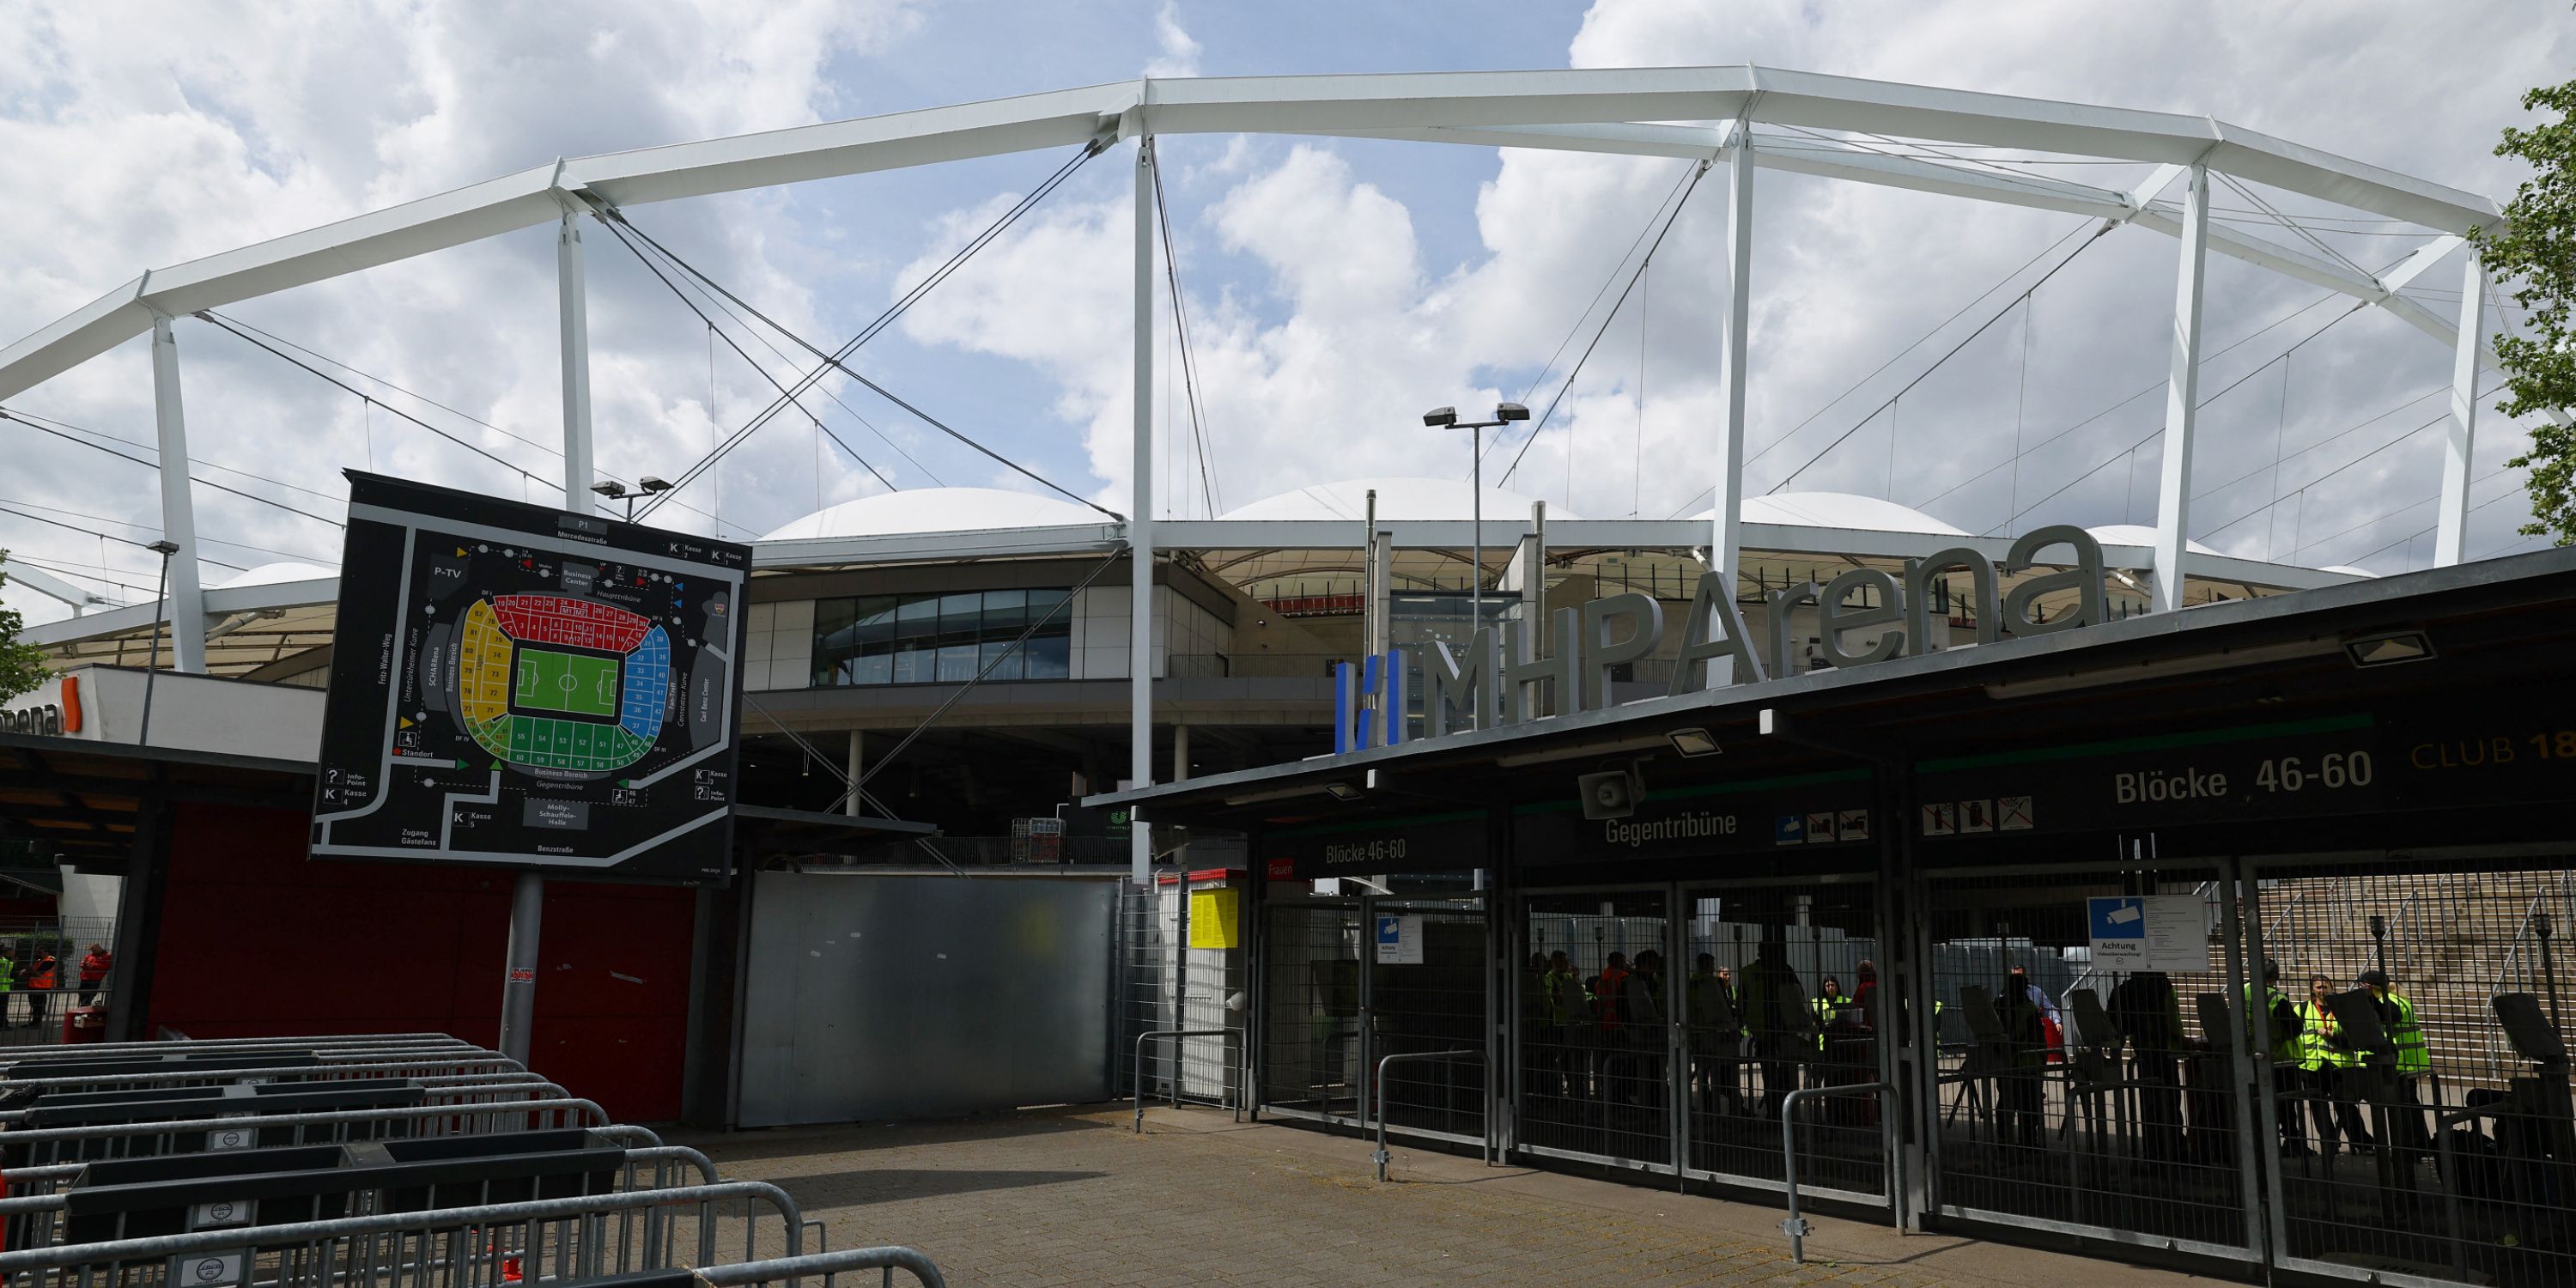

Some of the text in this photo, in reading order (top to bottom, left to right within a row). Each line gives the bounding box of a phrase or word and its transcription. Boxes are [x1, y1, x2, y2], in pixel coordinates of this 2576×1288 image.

[579, 521, 588, 529] P1
[558, 531, 607, 545] Mercedesstraße
[685, 545, 701, 553] Kasse
[726, 552, 741, 560] Kasse
[434, 567, 461, 578] P-TV
[564, 570, 591, 579] Business
[565, 578, 588, 586] Center
[597, 591, 641, 602] Haupttribüne
[378, 633, 392, 685] Fritz-Walter-Weg
[429, 647, 439, 687] SCHARRena
[446, 642, 457, 692] Business Bereich
[404, 648, 416, 702] Untertürkheimer
[402, 749, 433, 758] Standort
[2411, 736, 2515, 770] CLUB
[535, 768, 562, 776] Business
[2115, 750, 2372, 804] Blöcke 46-60
[536, 780, 584, 790] Gegentribüne
[402, 829, 429, 838] Zugang
[1605, 811, 1736, 847] Gegentribüne
[401, 837, 436, 846] Gästefans
[538, 845, 573, 853] Benzstraße
[1326, 838, 1406, 865] Blöcke 46-60
[1268, 864, 1292, 877] Frauen
[2102, 942, 2136, 950] Achtung
